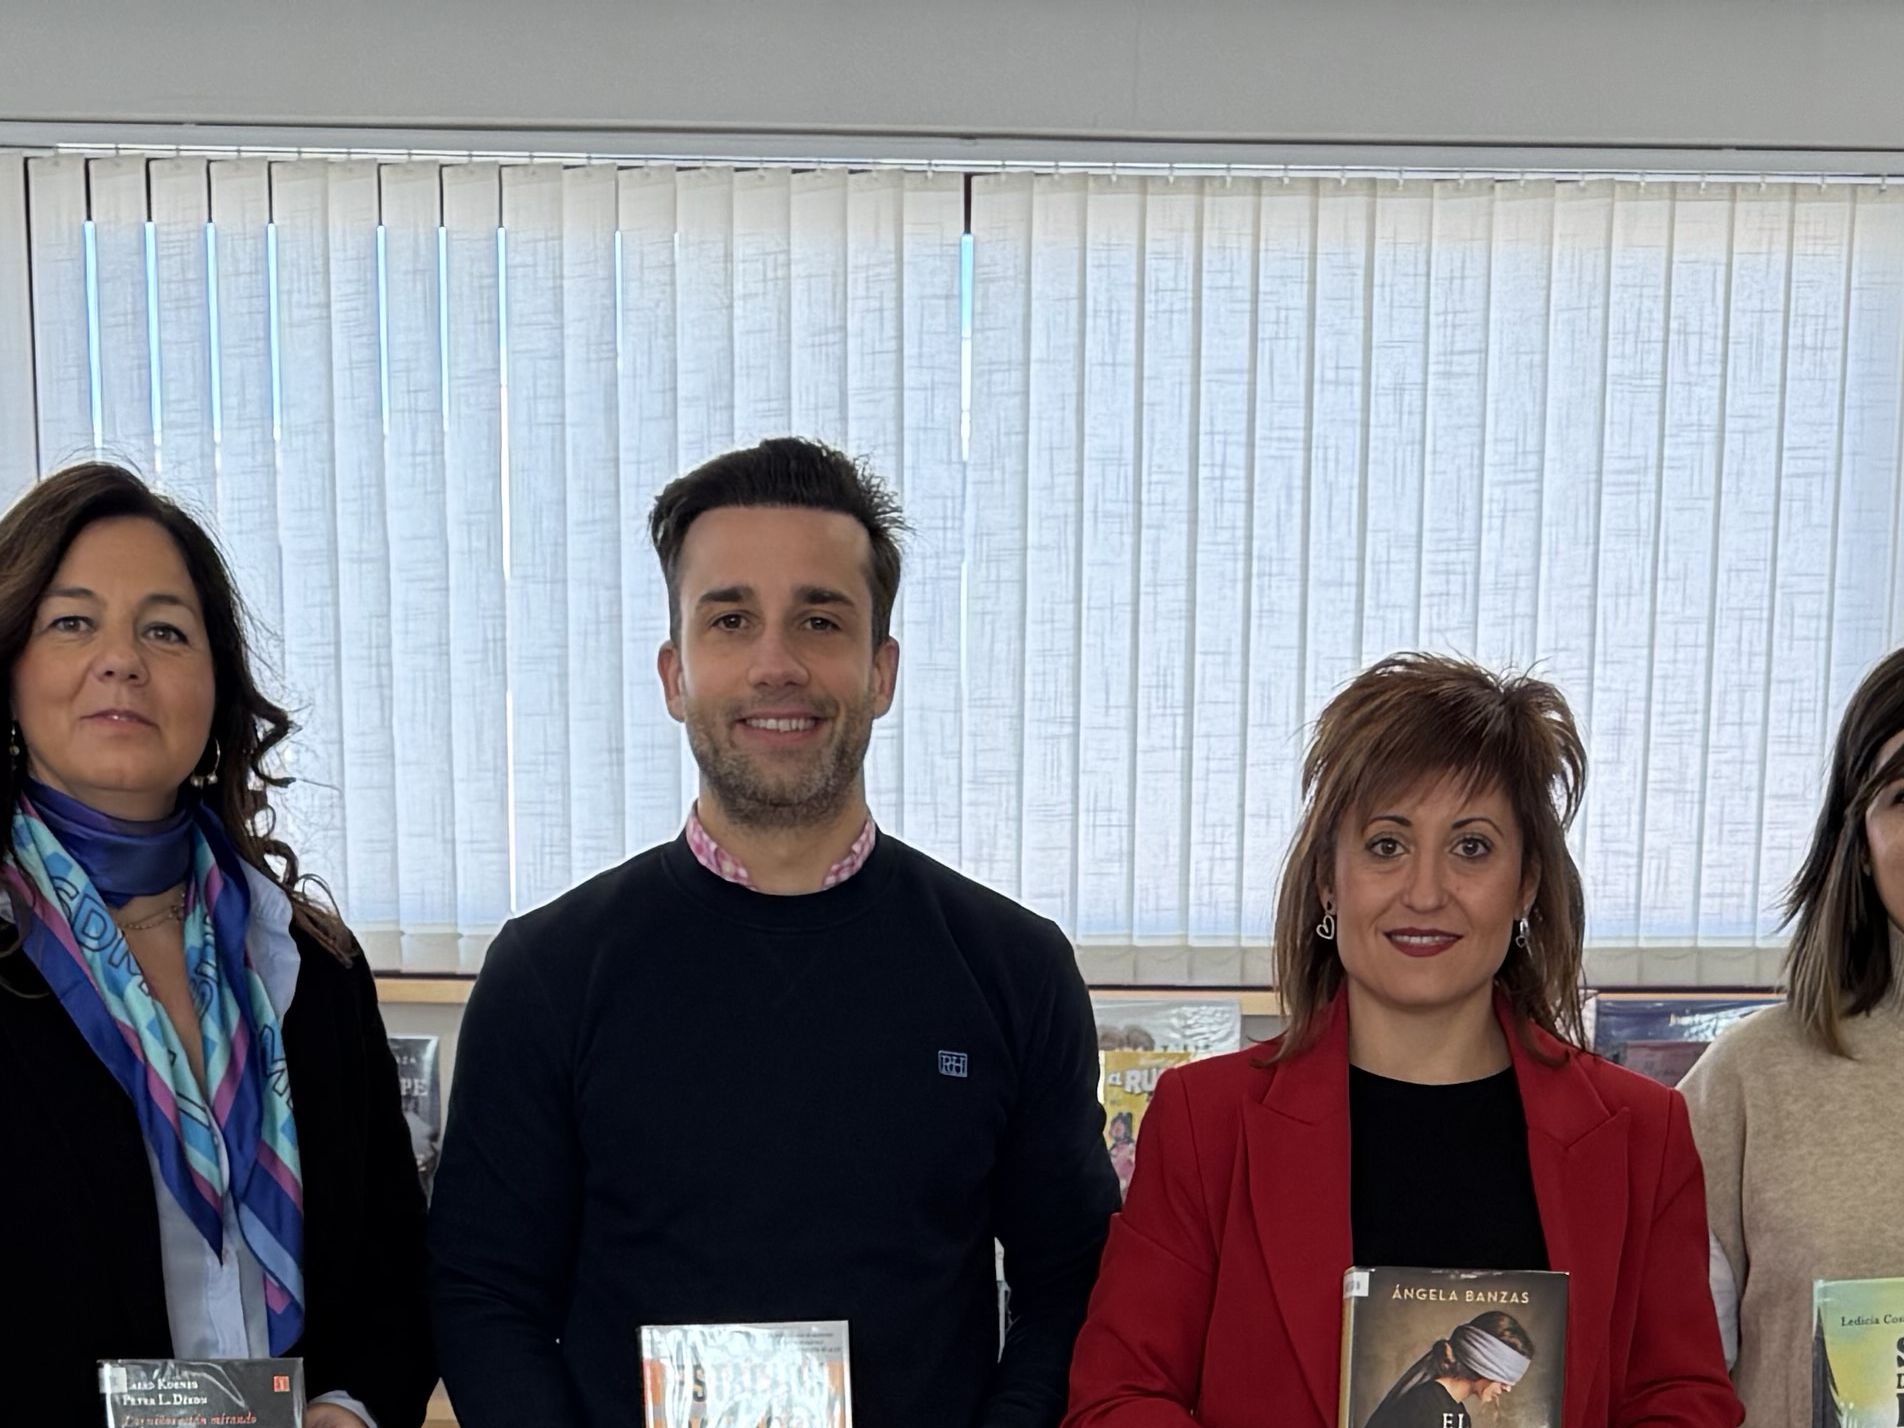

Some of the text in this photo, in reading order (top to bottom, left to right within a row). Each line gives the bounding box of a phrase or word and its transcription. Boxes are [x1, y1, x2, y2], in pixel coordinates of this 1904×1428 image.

[1392, 1284, 1530, 1304] ÁNGELA BANZAS
[1840, 1315, 1880, 1327] Ledicia
